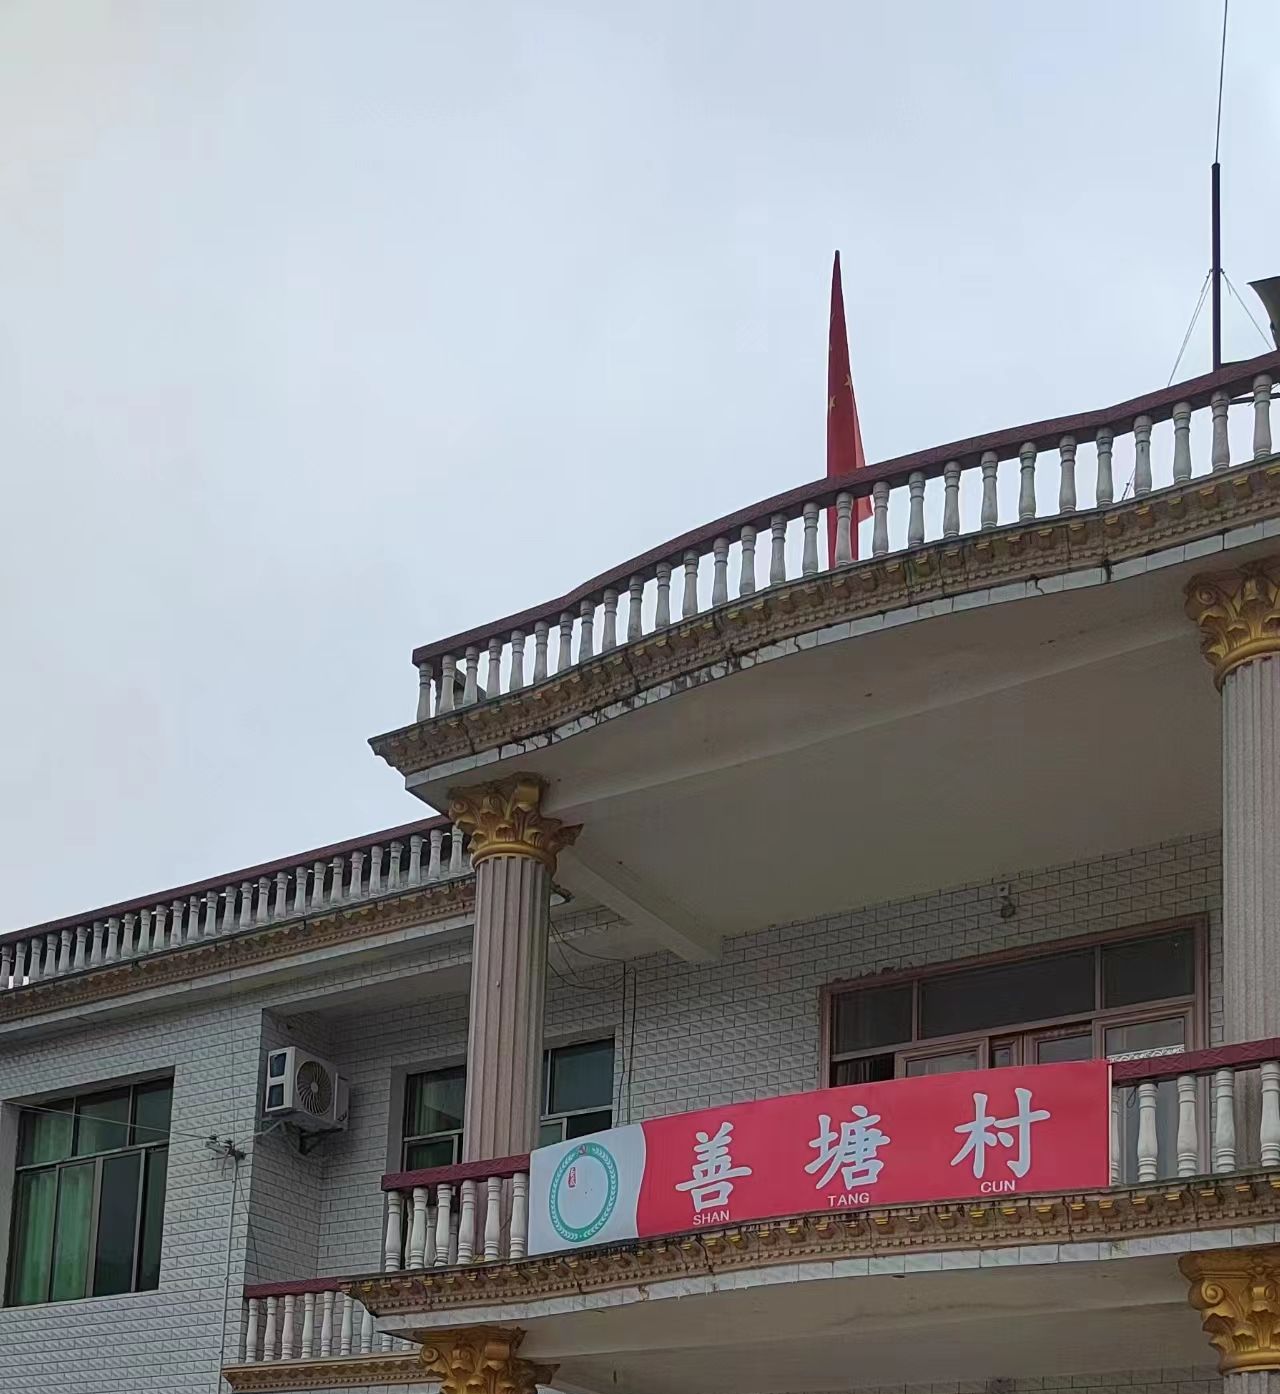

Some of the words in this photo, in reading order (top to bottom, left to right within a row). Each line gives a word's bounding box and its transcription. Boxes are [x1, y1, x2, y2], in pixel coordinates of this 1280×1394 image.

[676, 1087, 1051, 1212] 善塘村
[693, 1209, 730, 1225] SHAN
[827, 1191, 870, 1208] TANG
[980, 1179, 1016, 1194] CUN
